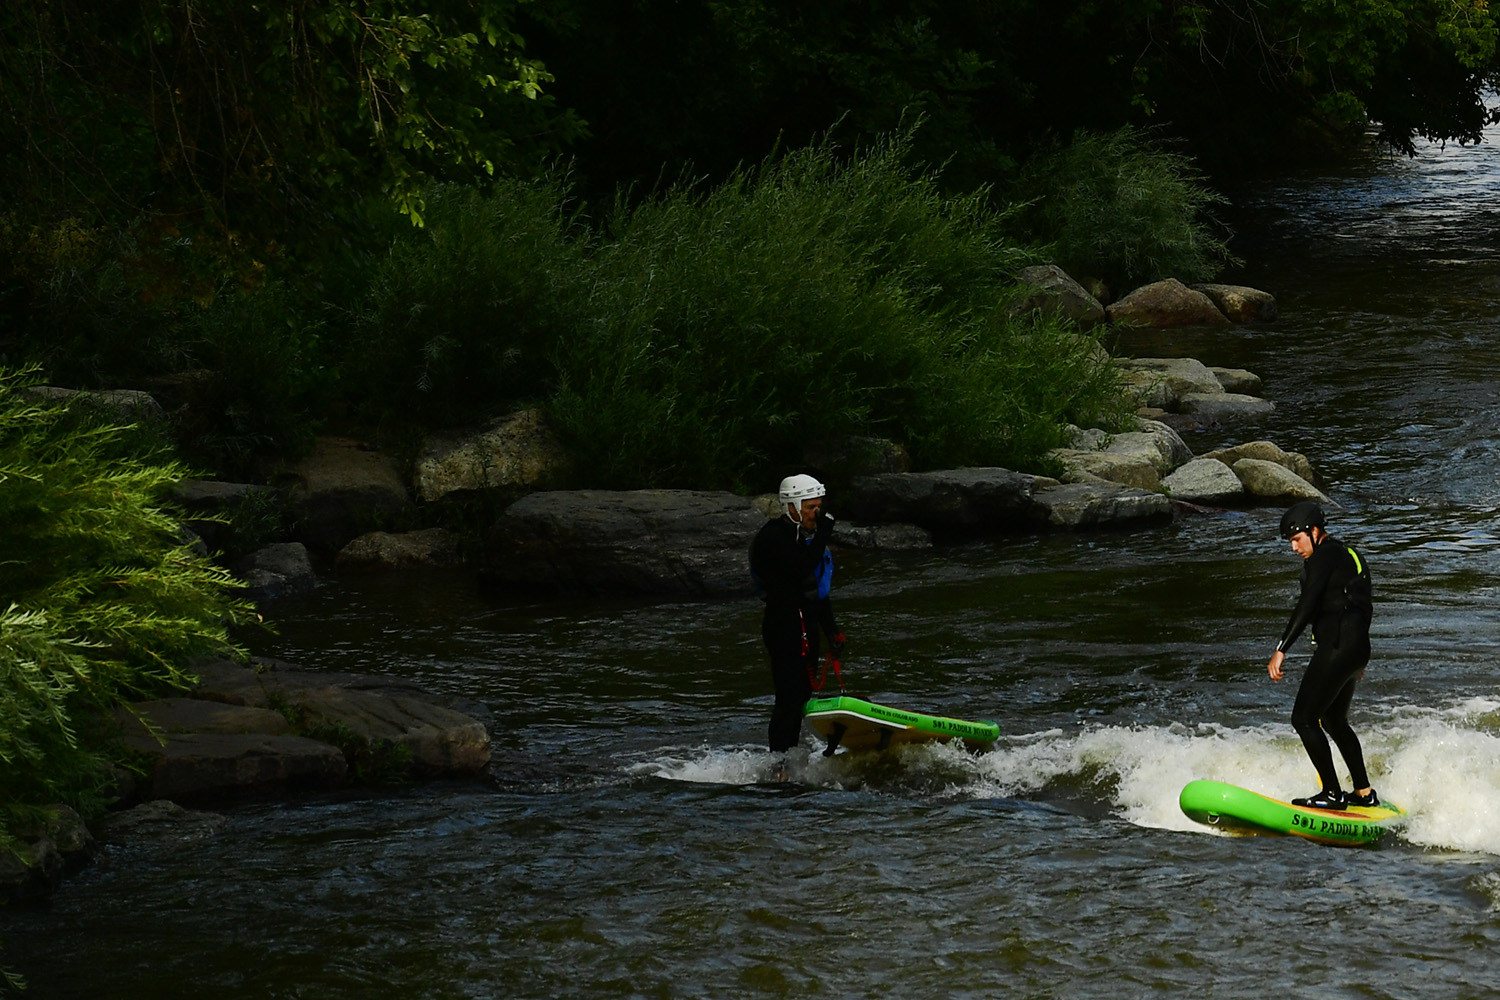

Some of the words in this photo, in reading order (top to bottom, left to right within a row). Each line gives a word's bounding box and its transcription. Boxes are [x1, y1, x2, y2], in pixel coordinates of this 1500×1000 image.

[932, 719, 946, 730] SOL
[948, 722, 972, 734] PADDLE
[1292, 814, 1316, 830] SOL
[1320, 821, 1359, 837] PADDLE
